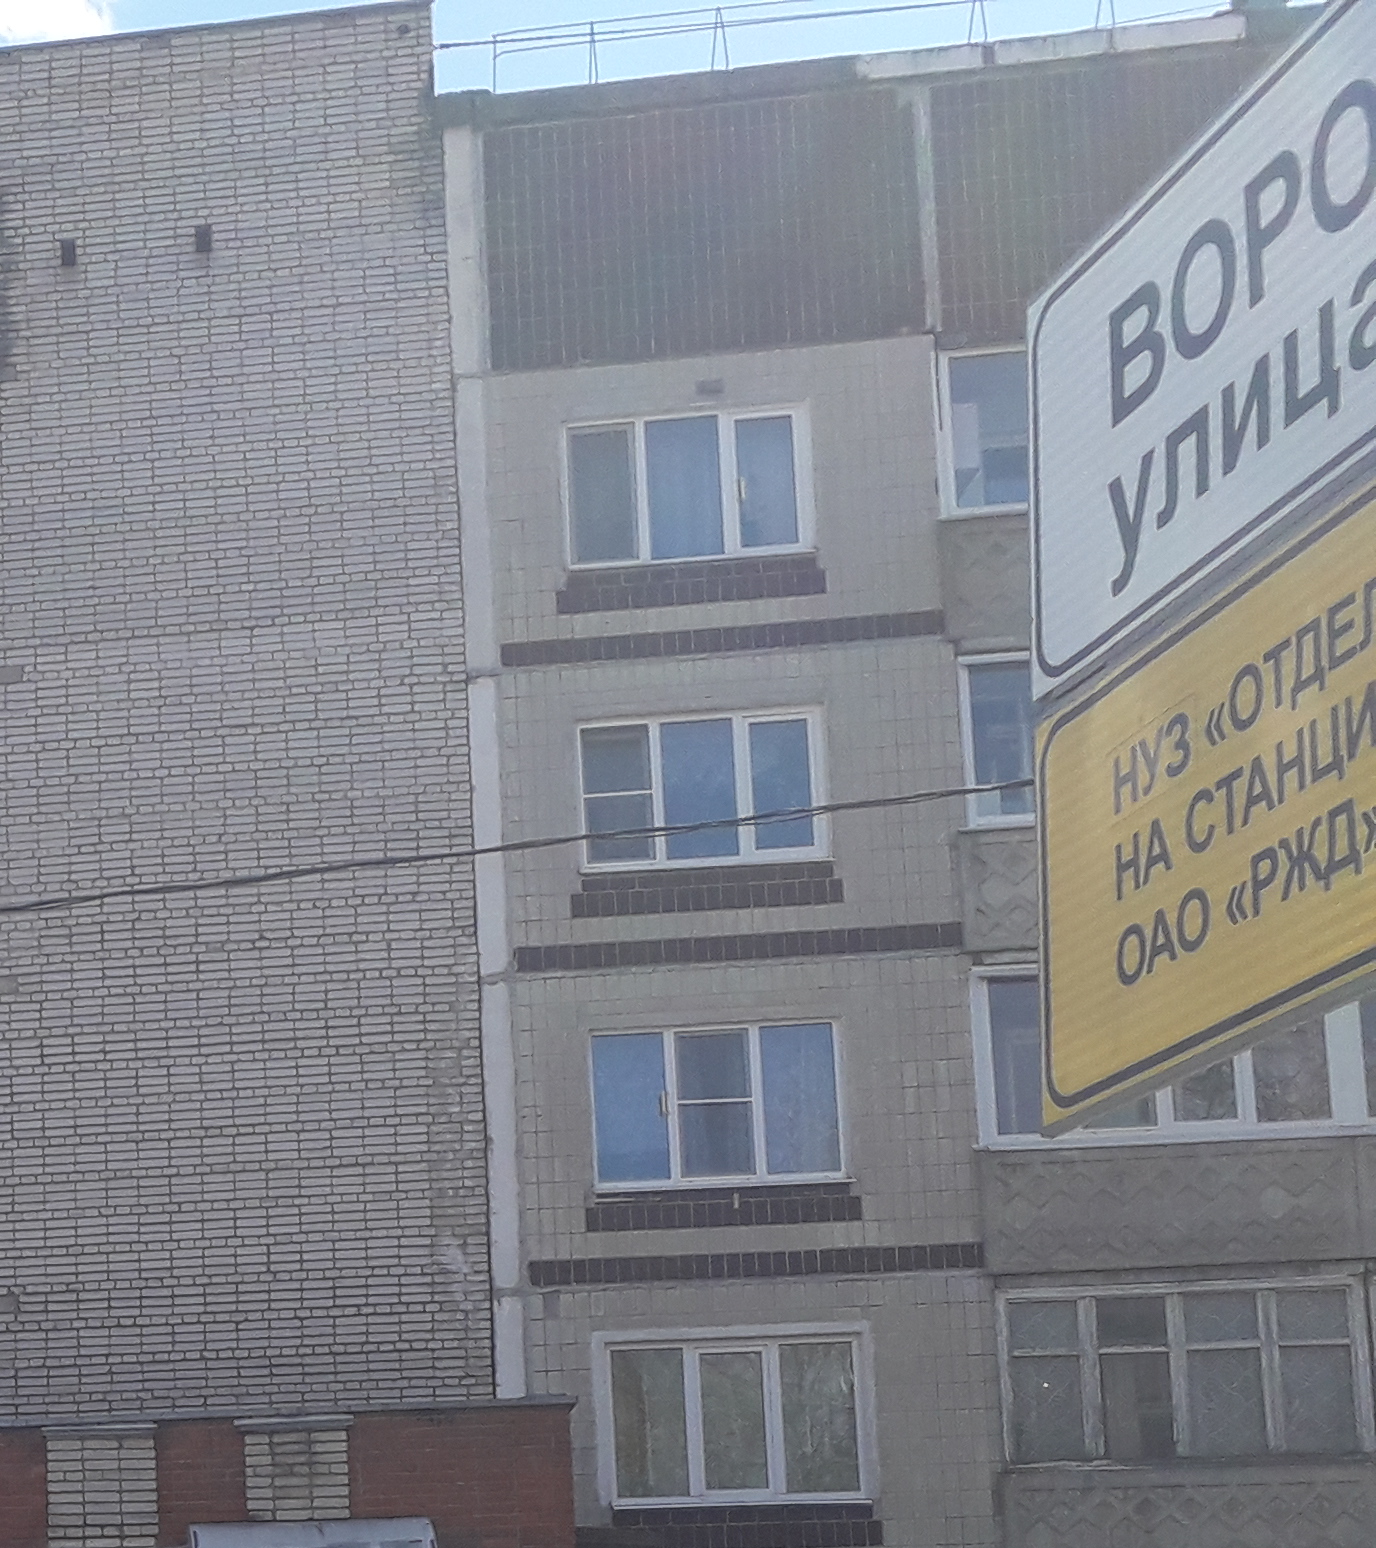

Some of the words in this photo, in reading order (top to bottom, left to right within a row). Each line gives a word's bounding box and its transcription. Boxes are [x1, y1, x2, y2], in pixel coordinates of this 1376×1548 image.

[1112, 711, 1193, 816] НУЗ
[1114, 817, 1174, 901] НА
[1116, 887, 1211, 986] ОАО
